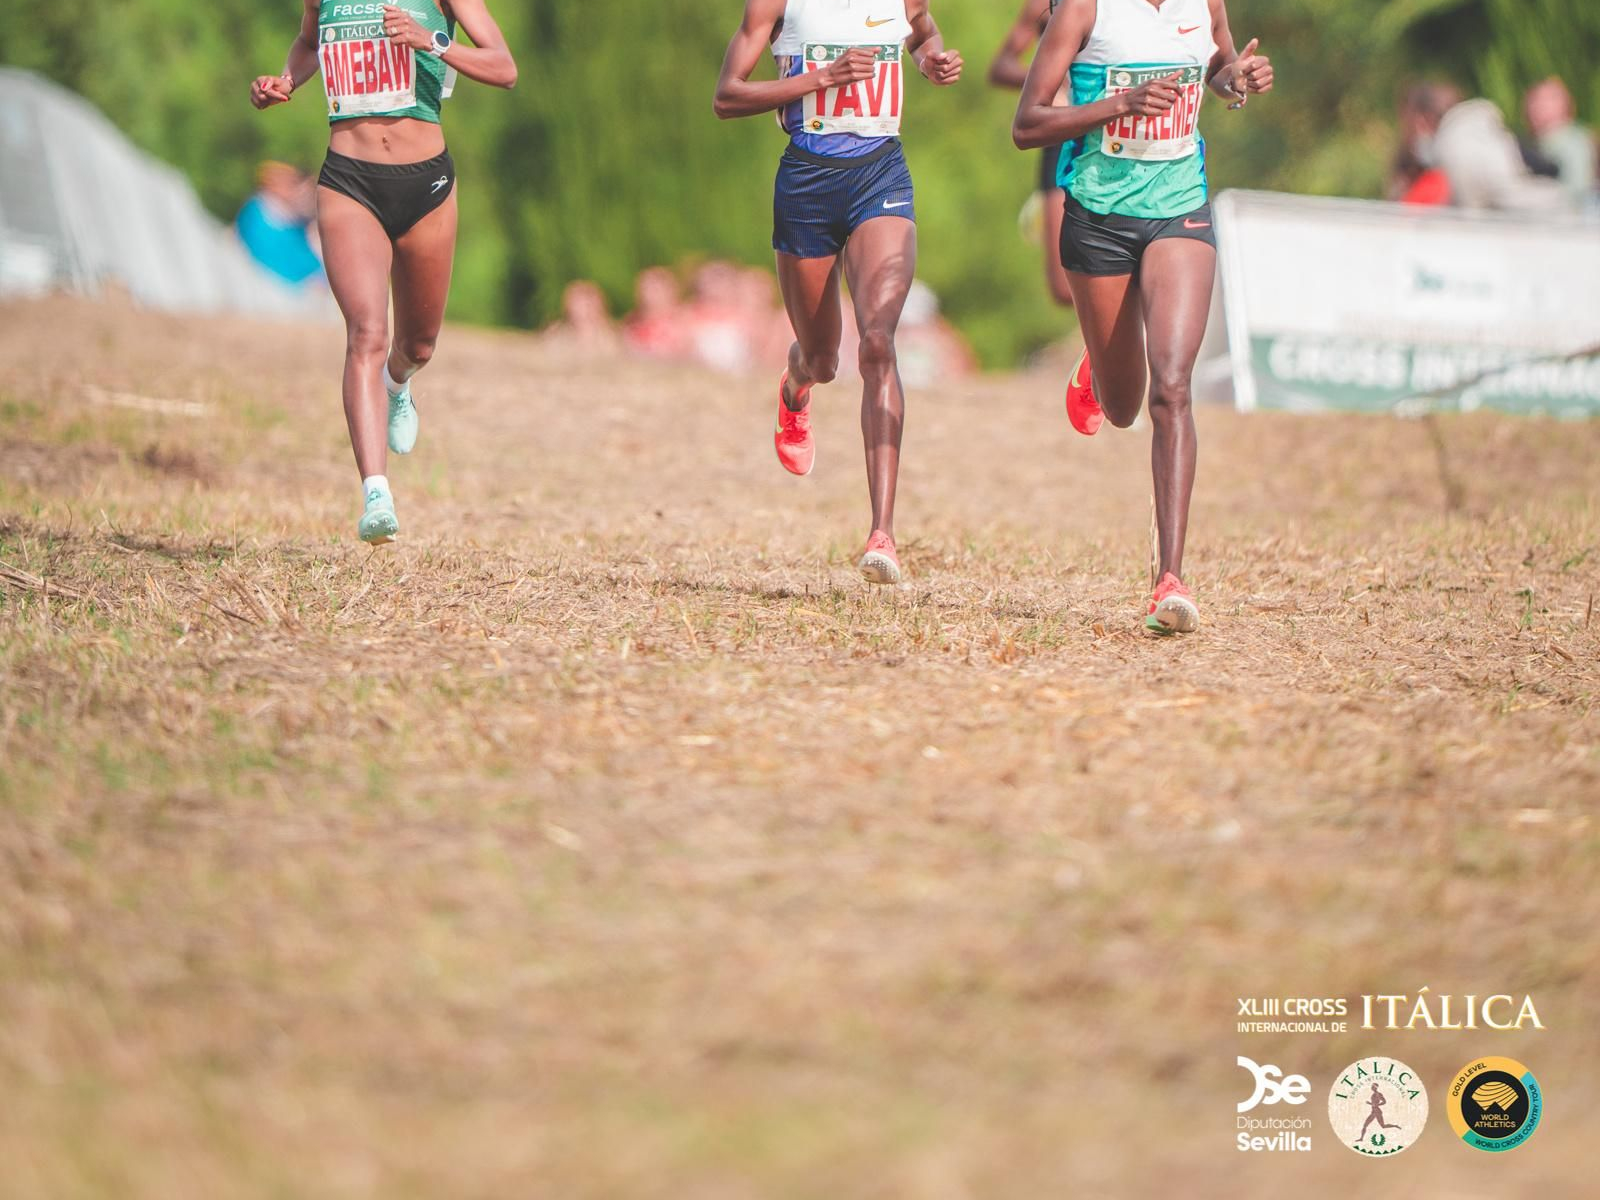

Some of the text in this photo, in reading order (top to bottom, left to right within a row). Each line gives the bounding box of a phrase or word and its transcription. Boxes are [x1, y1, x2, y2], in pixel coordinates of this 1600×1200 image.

[341, 25, 384, 39] ITÁLICA
[324, 39, 411, 97] AMEBAW
[806, 62, 899, 118] YAVI
